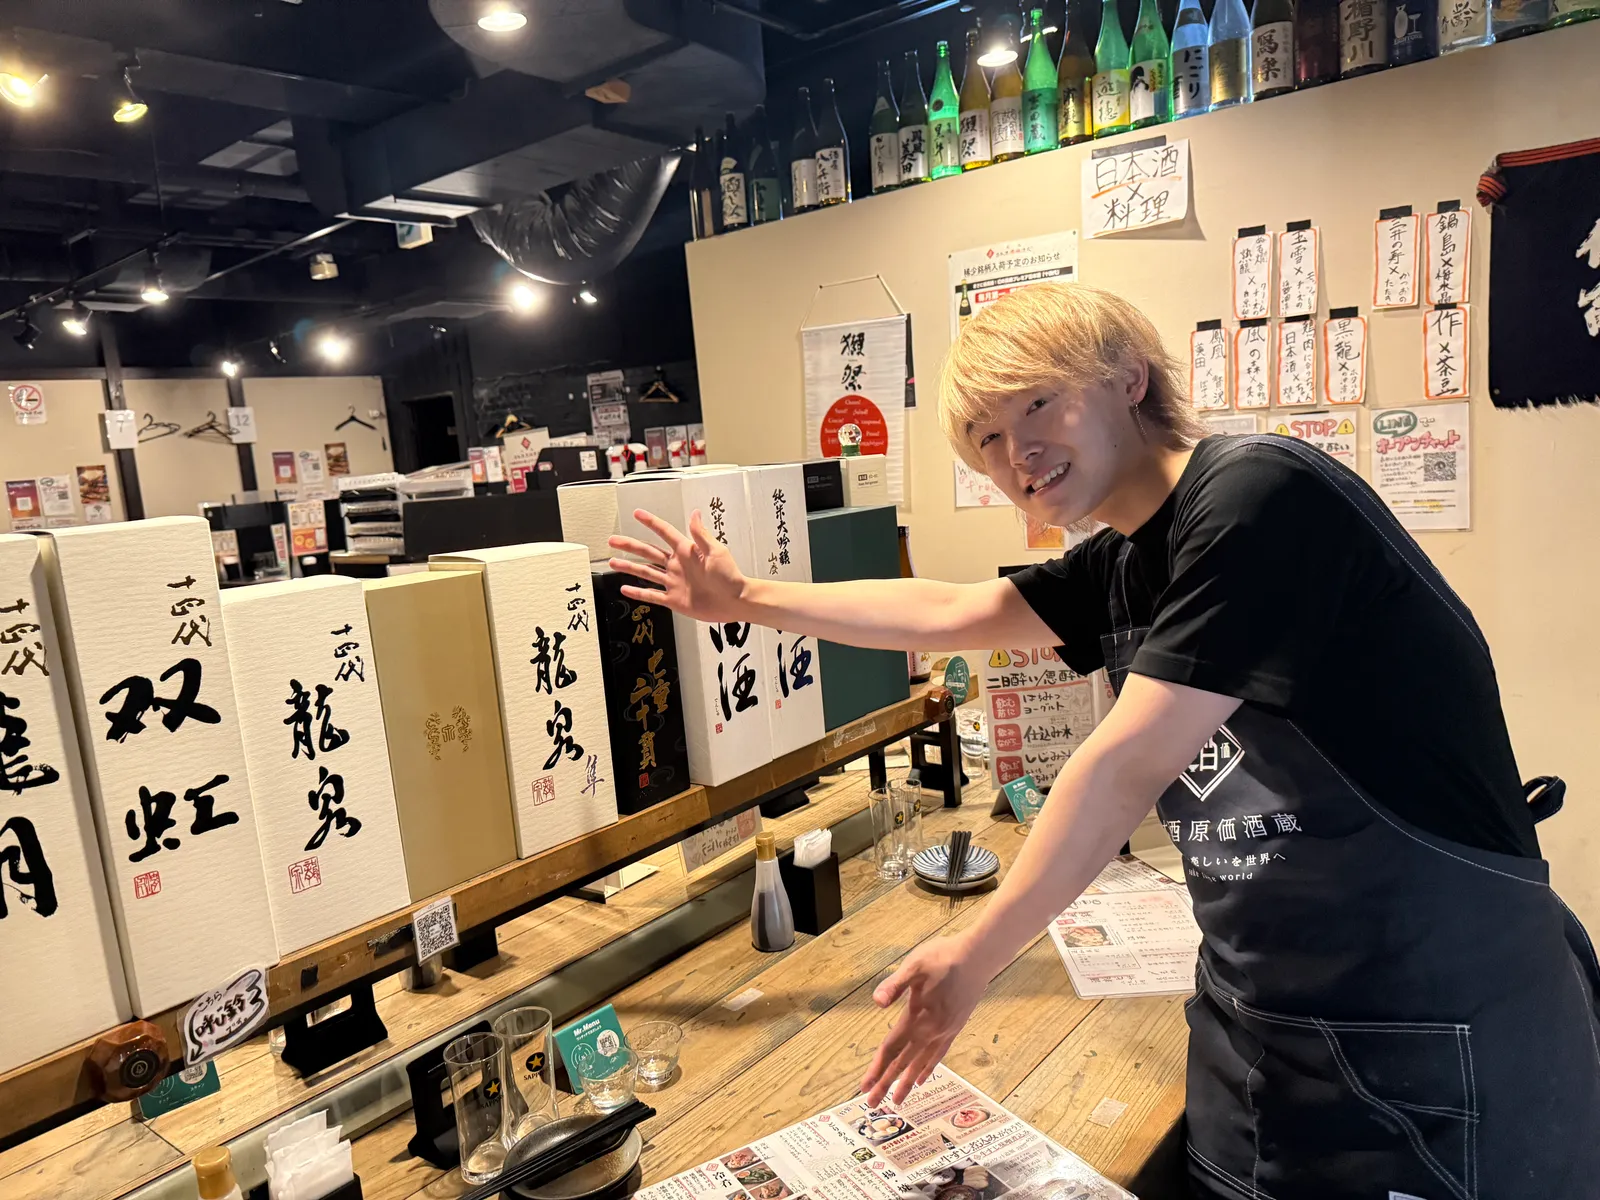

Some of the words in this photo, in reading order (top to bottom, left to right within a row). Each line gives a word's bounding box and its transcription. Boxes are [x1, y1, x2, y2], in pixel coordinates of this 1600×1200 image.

[1184, 49, 1204, 99] にごり
[1095, 146, 1180, 193] 日本酒
[1103, 190, 1172, 229] 料理
[840, 332, 866, 391] 獺祭
[234, 414, 250, 427] 12
[709, 496, 729, 545] 純米大
[167, 576, 213, 648] 十四代
[565, 582, 590, 632] 十四代
[631, 603, 654, 646] 四代
[0, 598, 51, 678] 十四代
[331, 623, 365, 683] 十四代
[776, 629, 814, 699] 酒
[530, 626, 585, 771] 龍泉
[1023, 702, 1064, 714] ヨーグルト
[1023, 724, 1073, 743] 仕込み水
[99, 657, 240, 863] 双虹
[282, 678, 363, 852] 龍泉
[580, 754, 605, 797] 隼
[1220, 872, 1253, 882] world
[195, 993, 246, 1037] 呼び鈴
[197, 991, 223, 1013] こちら
